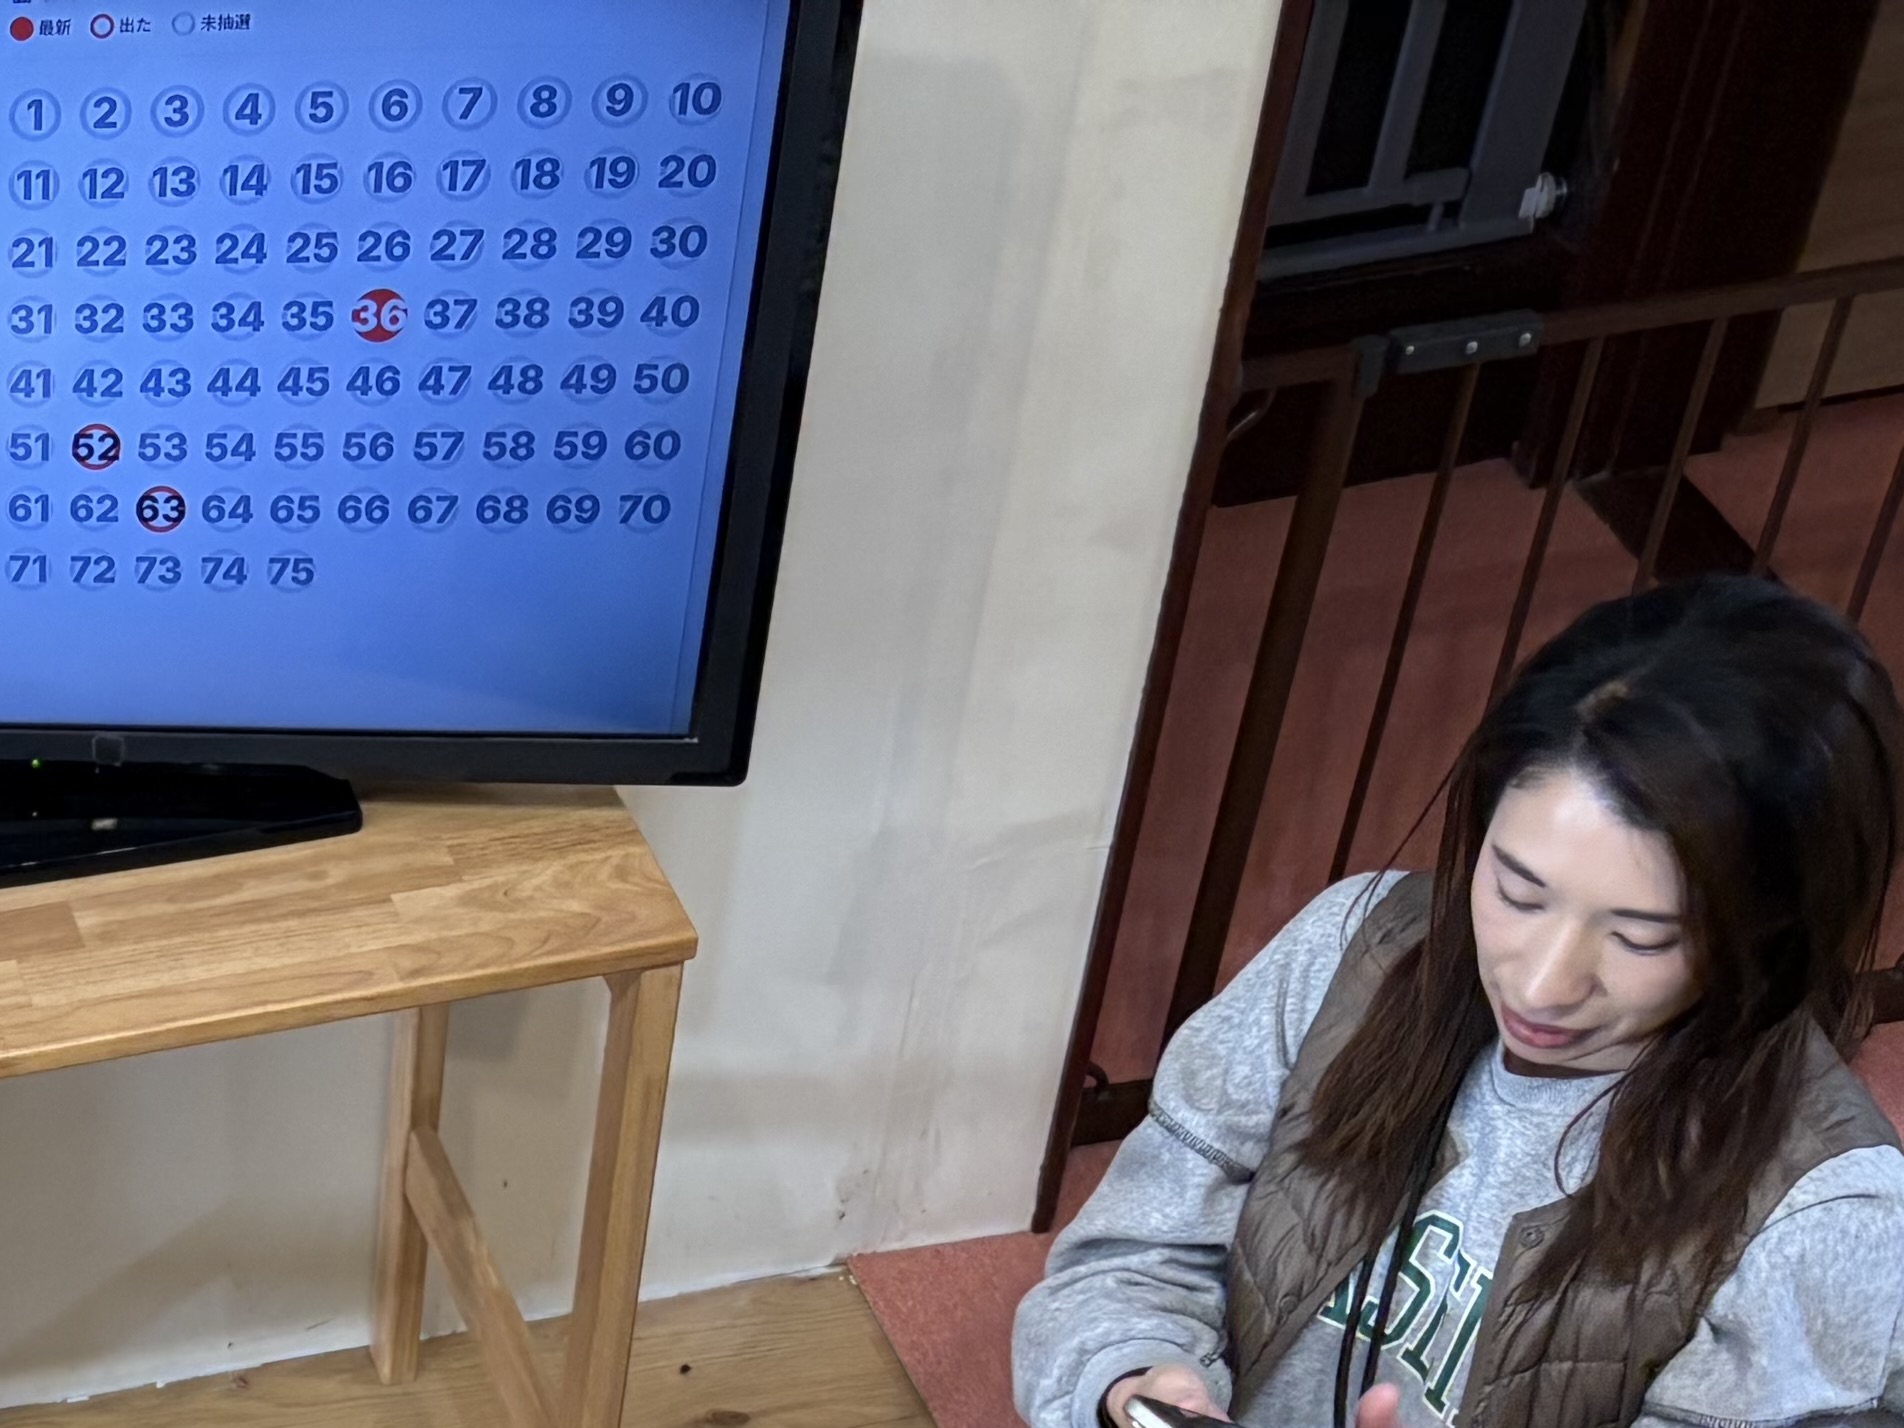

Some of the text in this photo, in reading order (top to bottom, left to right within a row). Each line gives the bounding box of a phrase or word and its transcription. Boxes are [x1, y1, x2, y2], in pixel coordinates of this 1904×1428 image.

[39, 13, 252, 36] 最新 出た 未抽選
[27, 81, 722, 131] 1 2 3 4 5 6 7 8 9 10
[16, 154, 717, 201] 11 12 13 14 15 16 17 18 19 20
[11, 224, 708, 268] 21 22 23 24 25 26 27 28 29 30
[10, 295, 699, 335] 31 32 33 34 35 36 37 38 39 40
[9, 362, 690, 399] 41 42 43 44 45 46 47 48 49 50
[9, 429, 681, 463] 51 52 53 54 55 56 57 58 59 60
[8, 493, 671, 525] 61 62 63 64 65 66 67 68 69 70
[9, 554, 315, 586] 71 72 73 74 75
